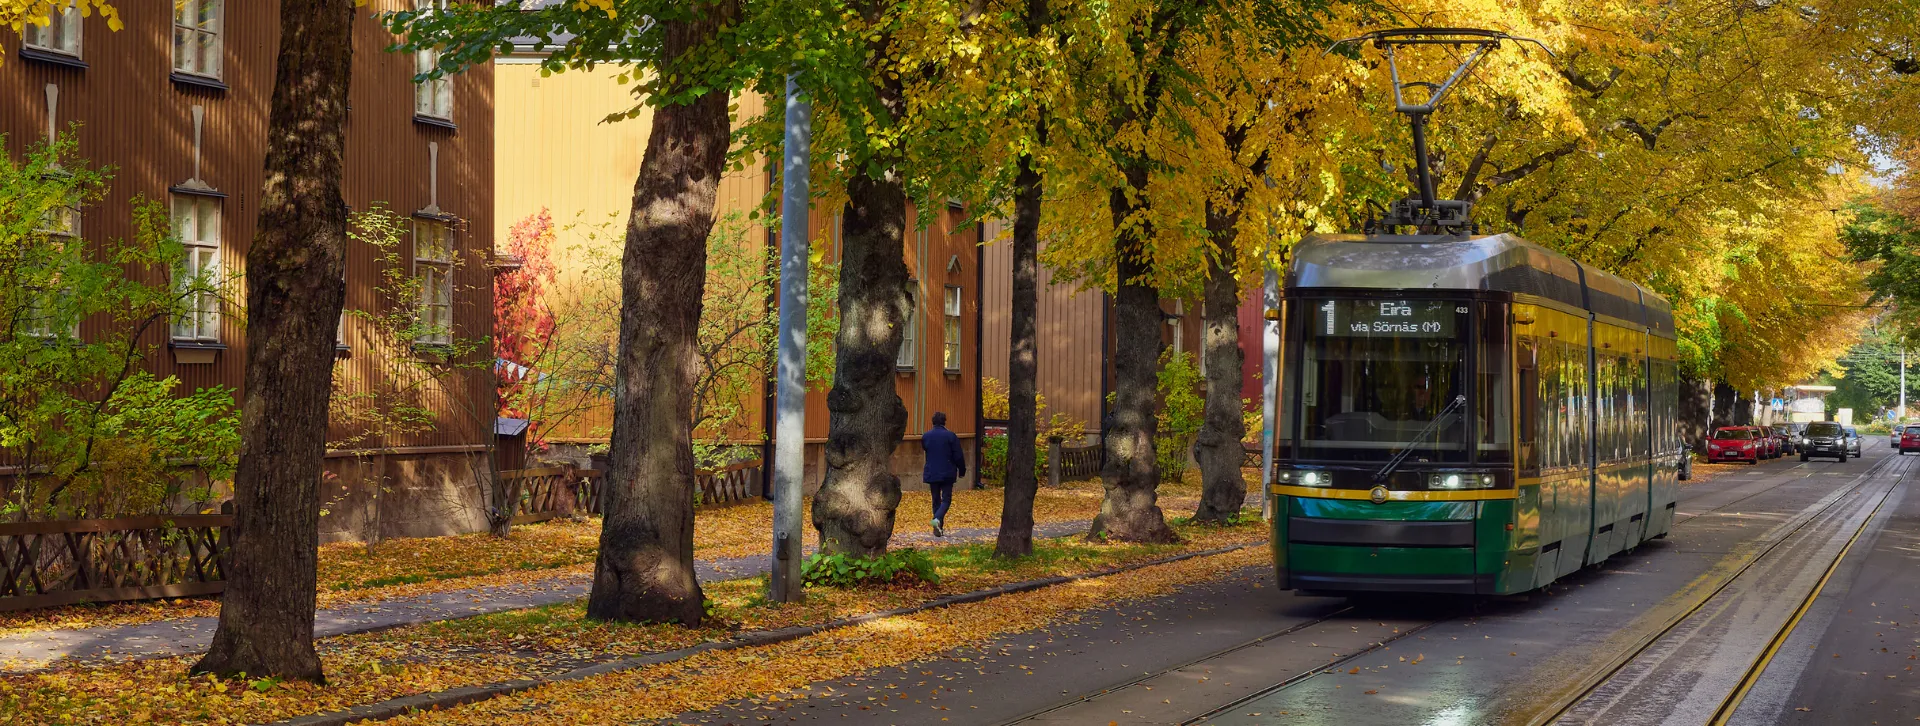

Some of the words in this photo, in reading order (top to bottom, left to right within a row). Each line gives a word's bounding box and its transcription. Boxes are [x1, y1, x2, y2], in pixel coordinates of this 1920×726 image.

[1380, 302, 1412, 316] Eira
[1455, 306, 1469, 314] 433
[1321, 300, 1335, 335] 1
[1350, 321, 1369, 332] via
[1373, 321, 1418, 332] Sörnäs
[1422, 321, 1441, 332] (M)
